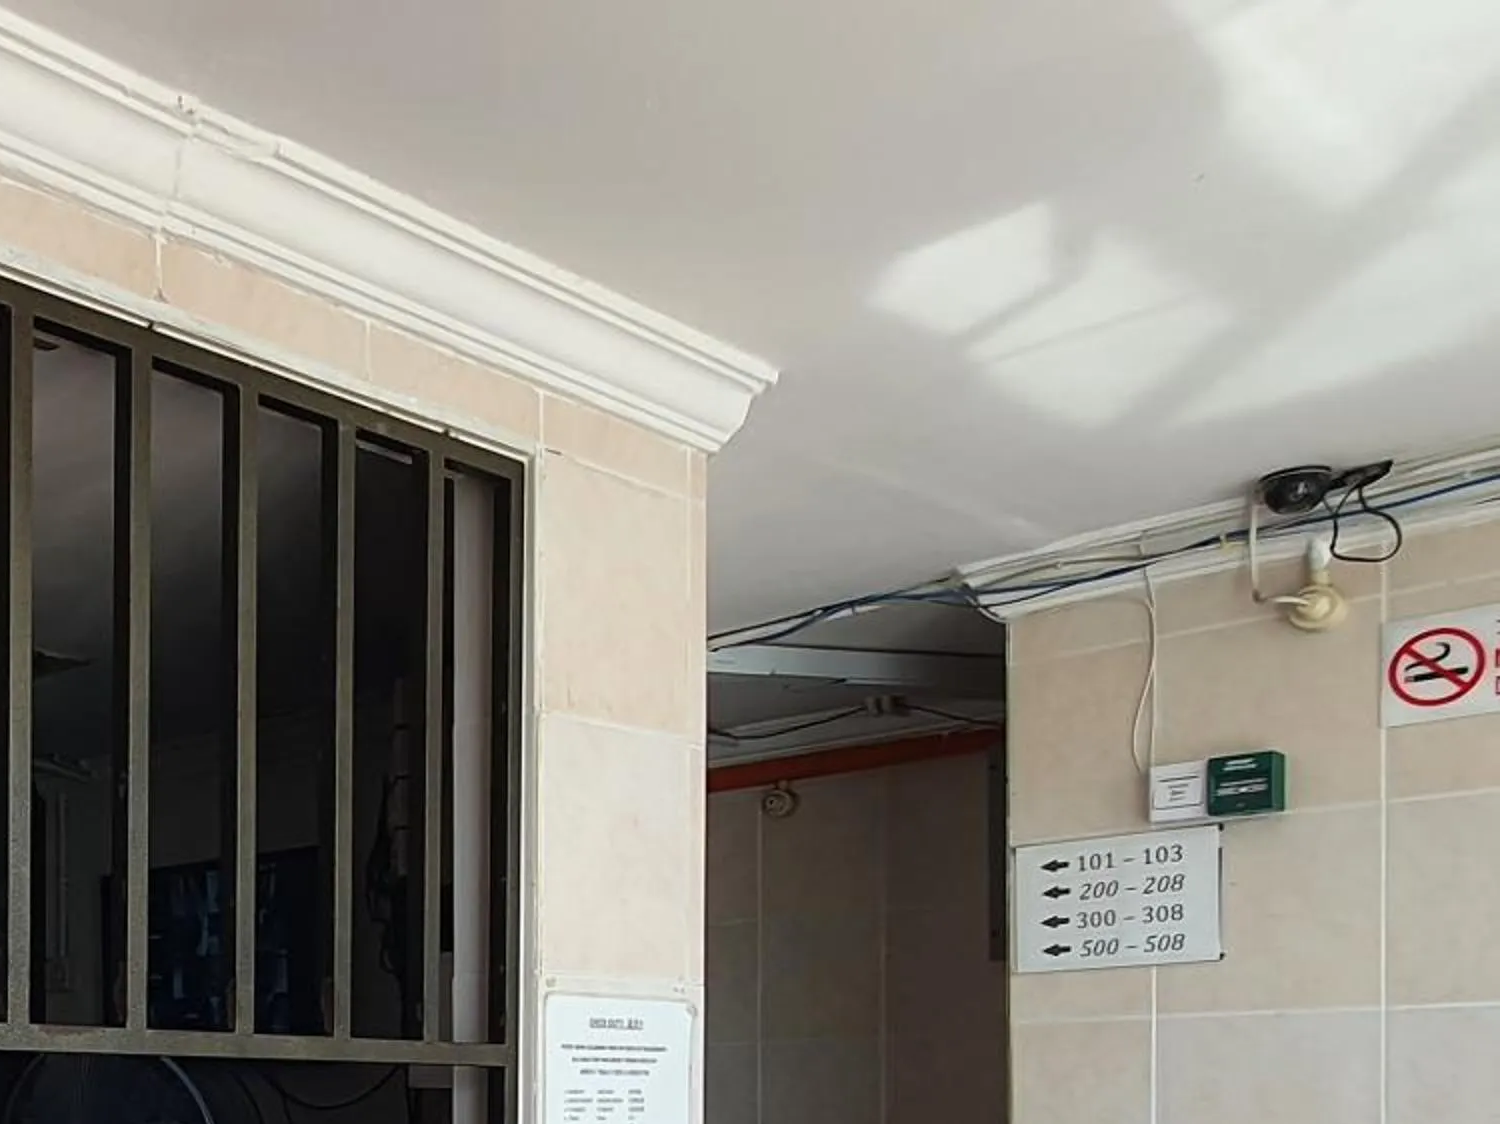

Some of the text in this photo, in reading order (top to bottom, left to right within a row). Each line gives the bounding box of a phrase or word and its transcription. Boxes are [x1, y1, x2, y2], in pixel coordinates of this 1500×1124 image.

[1079, 853, 1114, 871] 101
[1145, 845, 1182, 864] 103
[1080, 880, 1118, 900] 200
[1143, 874, 1184, 894] 208
[1078, 910, 1116, 928] 300
[1143, 904, 1183, 923] 308
[1080, 939, 1118, 957] 500
[1144, 934, 1184, 952] 508
